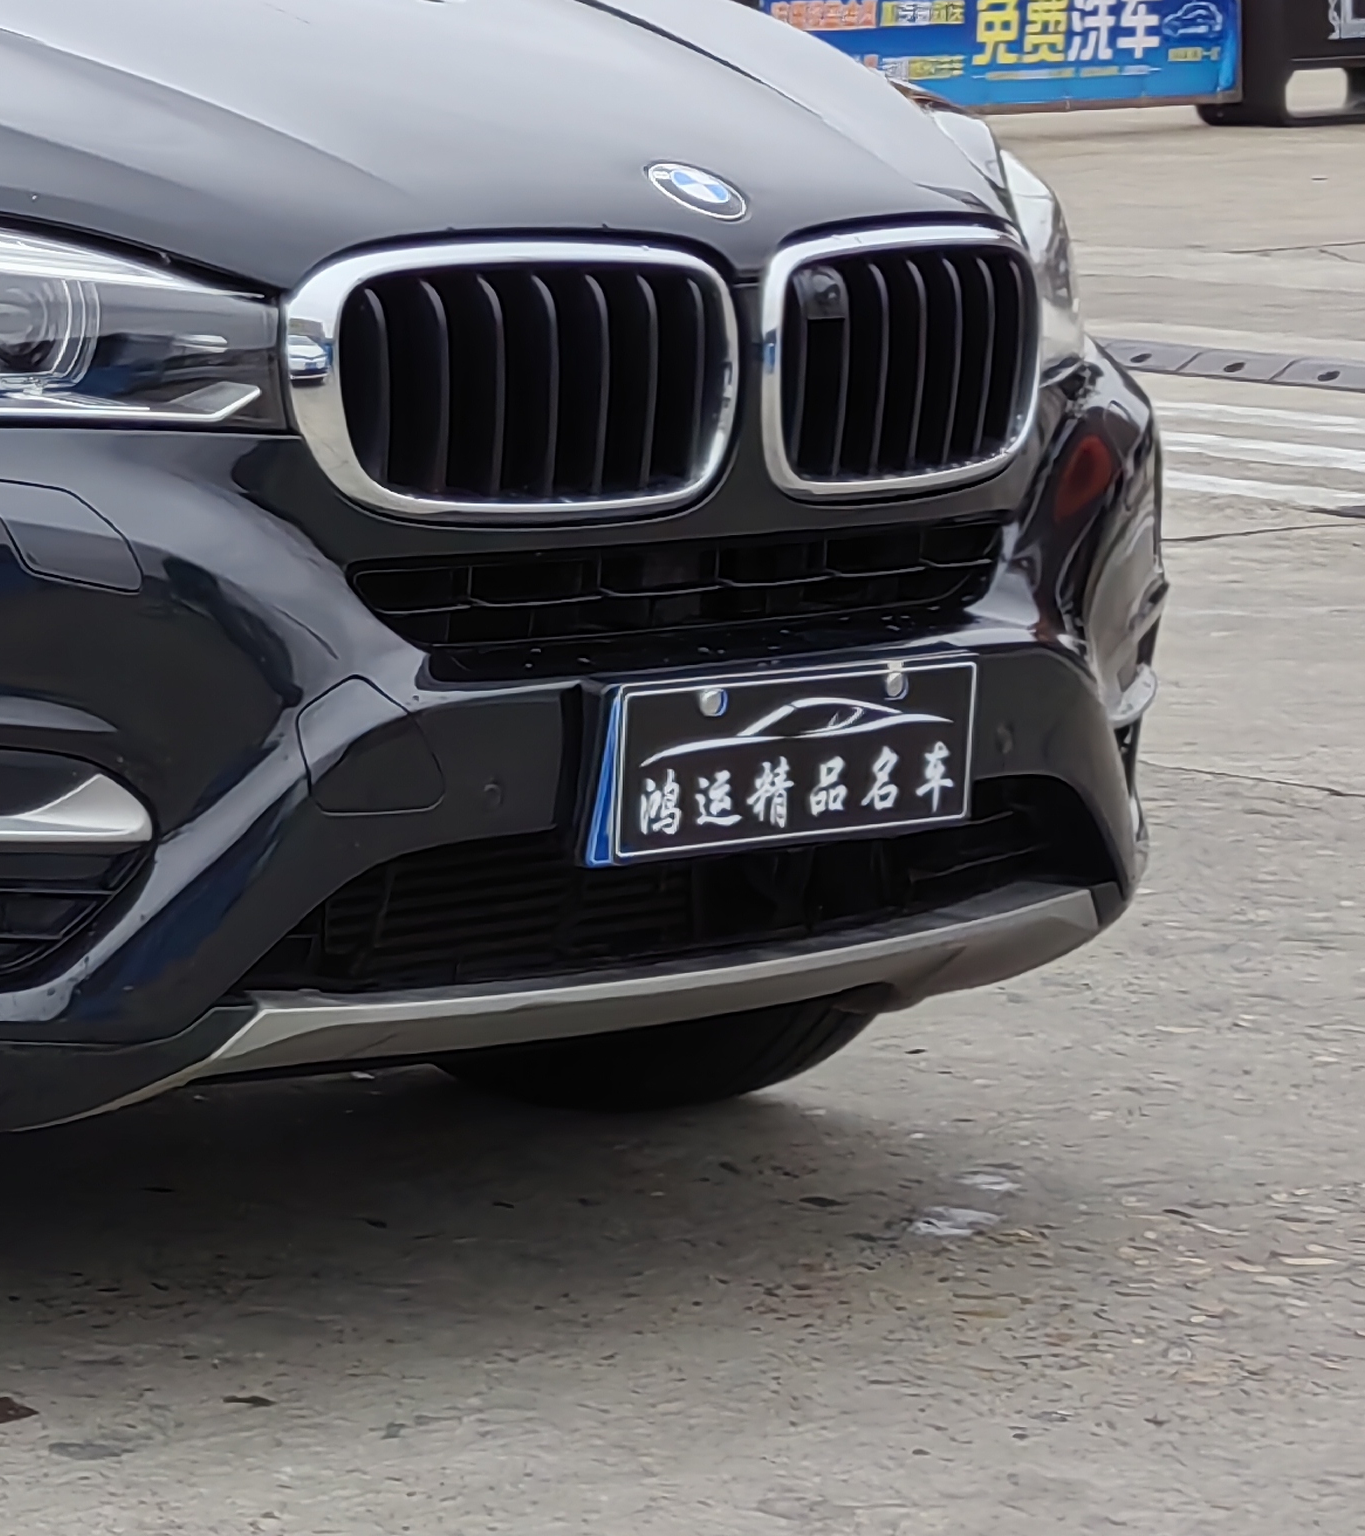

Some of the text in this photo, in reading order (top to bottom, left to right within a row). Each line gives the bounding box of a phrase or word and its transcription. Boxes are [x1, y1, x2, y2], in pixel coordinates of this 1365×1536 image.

[640, 741, 954, 835] 鸿运精品名车
